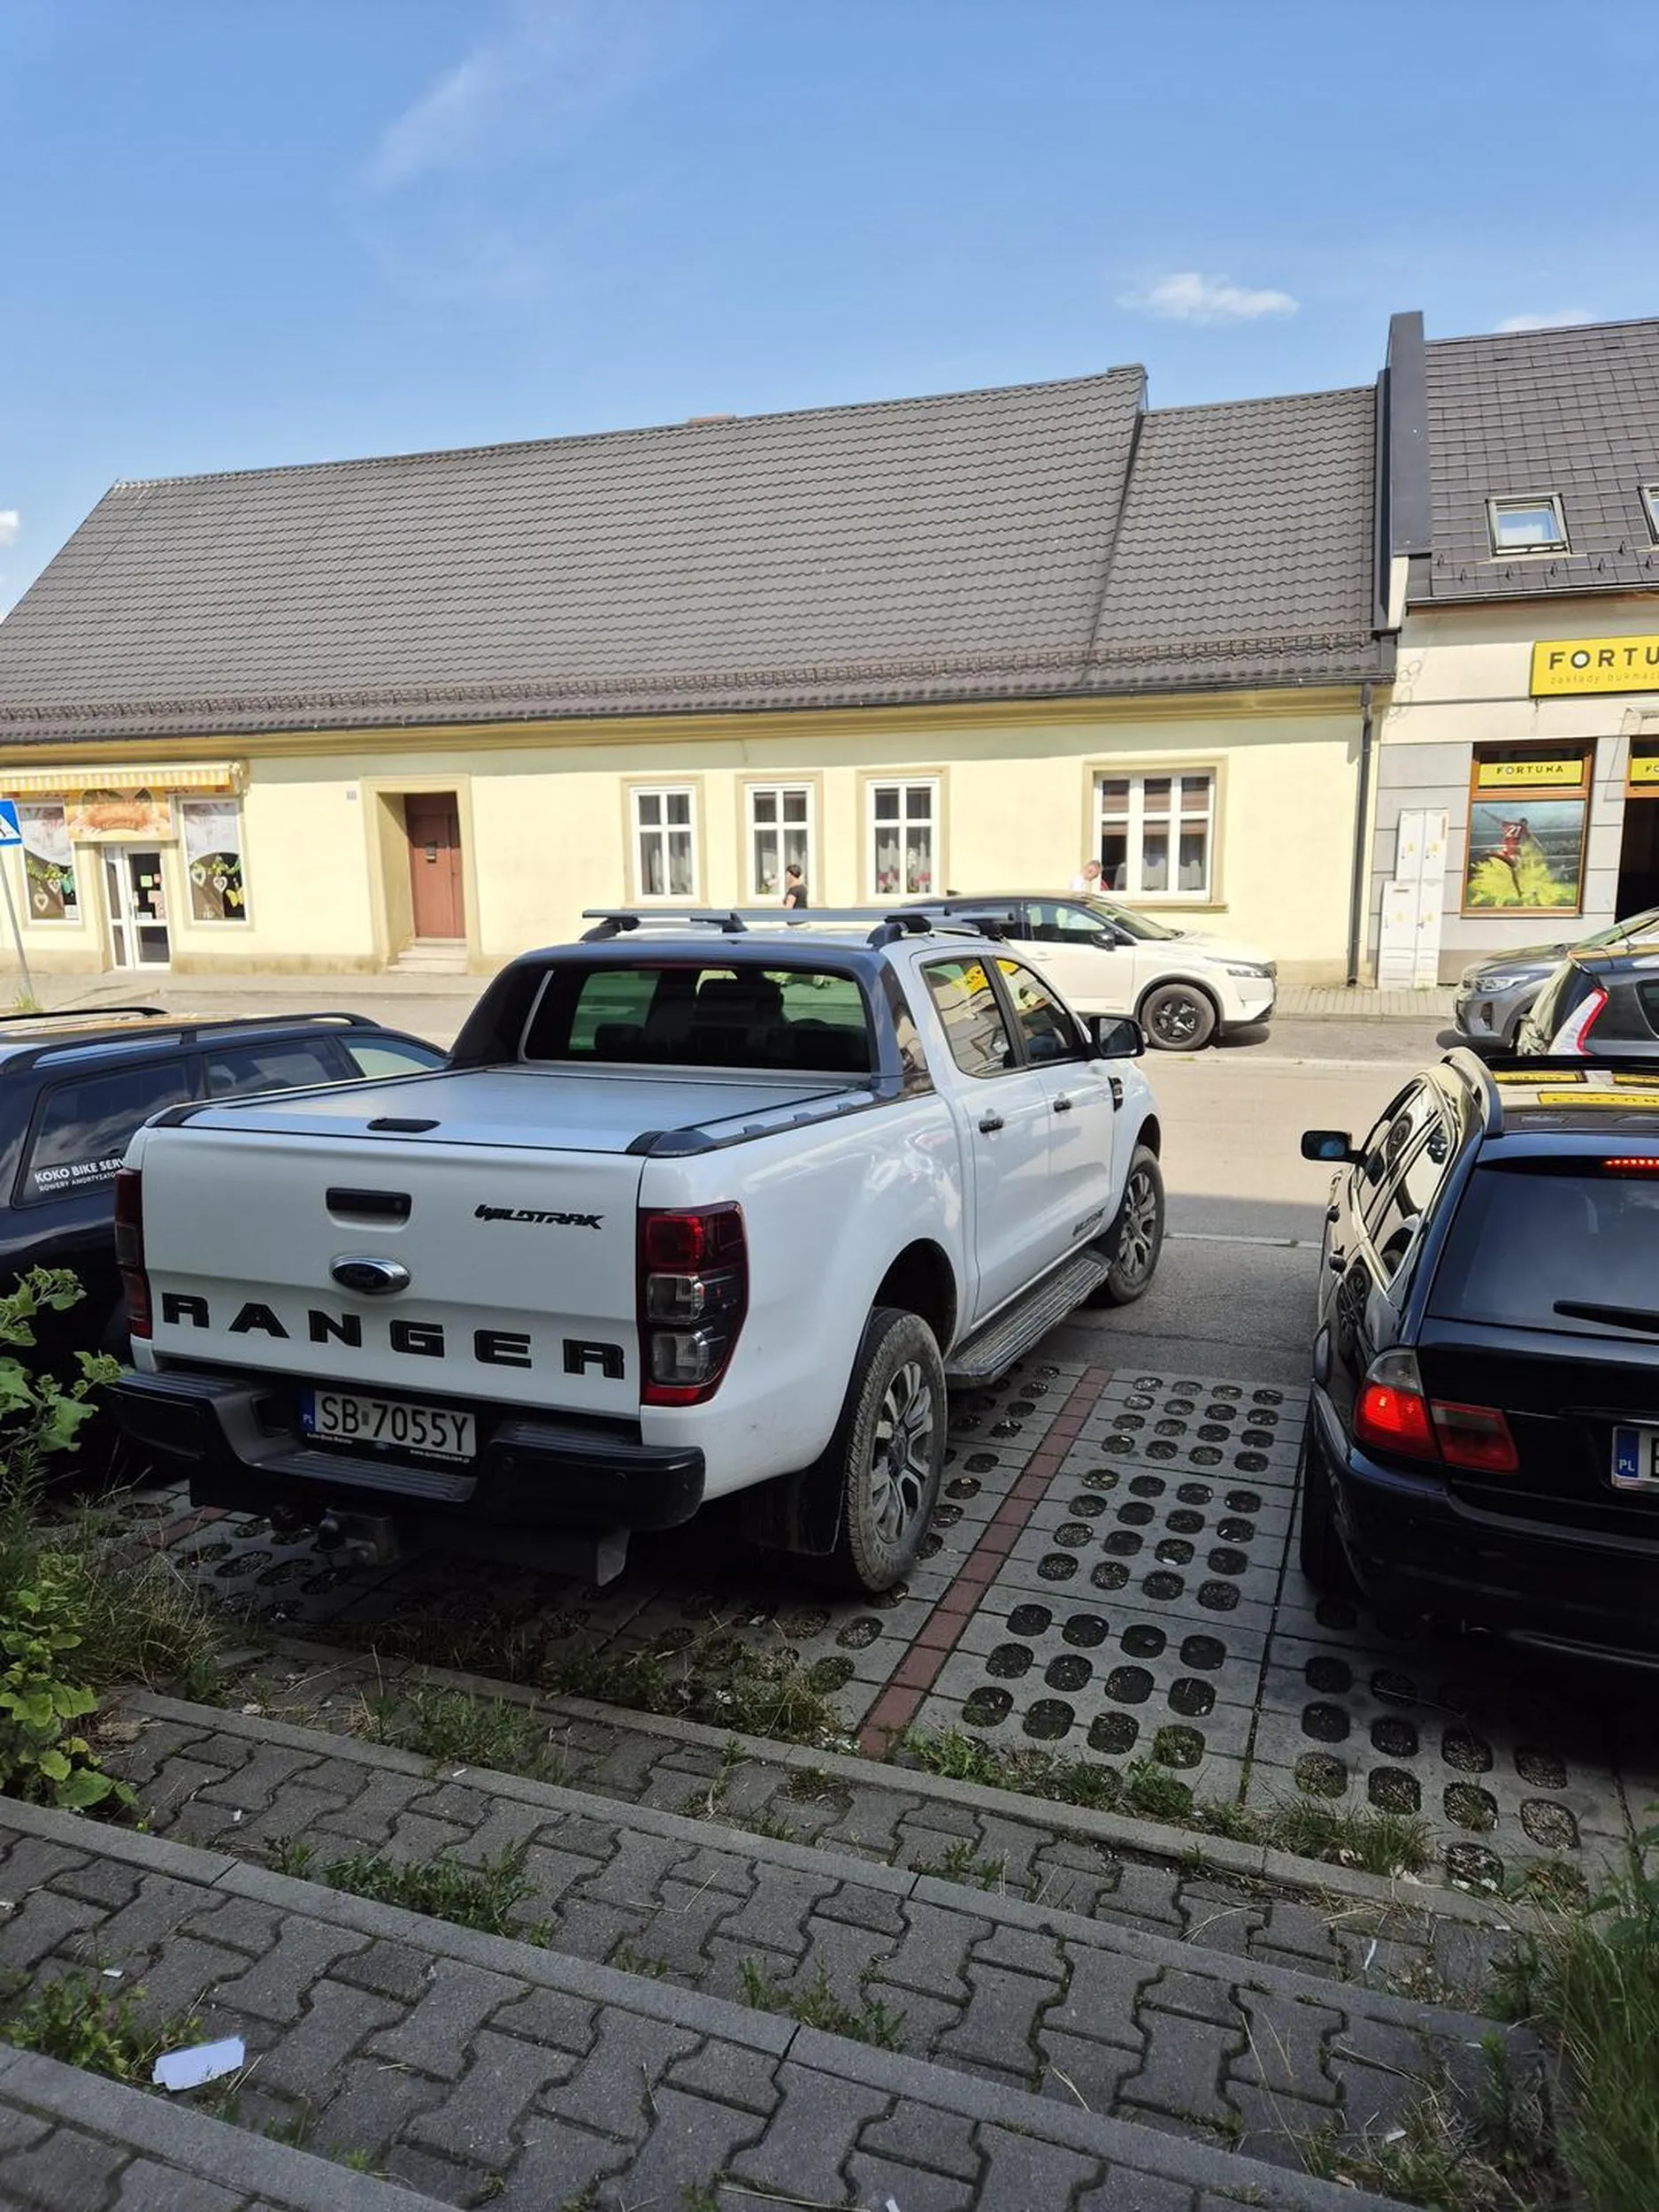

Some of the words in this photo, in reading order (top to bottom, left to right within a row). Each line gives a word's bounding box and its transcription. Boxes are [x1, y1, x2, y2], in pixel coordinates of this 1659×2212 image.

[1548, 647, 1659, 670] FORTU
[1496, 764, 1564, 775] FORTUNA
[35, 1168, 70, 1184] KOKO
[72, 1162, 98, 1176] BIKE
[38, 1180, 69, 1192] ROWERY
[72, 1171, 117, 1186] AMORTYZATO
[473, 1203, 604, 1230] WILDTRAK
[161, 1291, 625, 1380] RANGER
[321, 1395, 359, 1434] SB
[372, 1402, 468, 1452] 7055Y
[1618, 1458, 1635, 1472] PL
